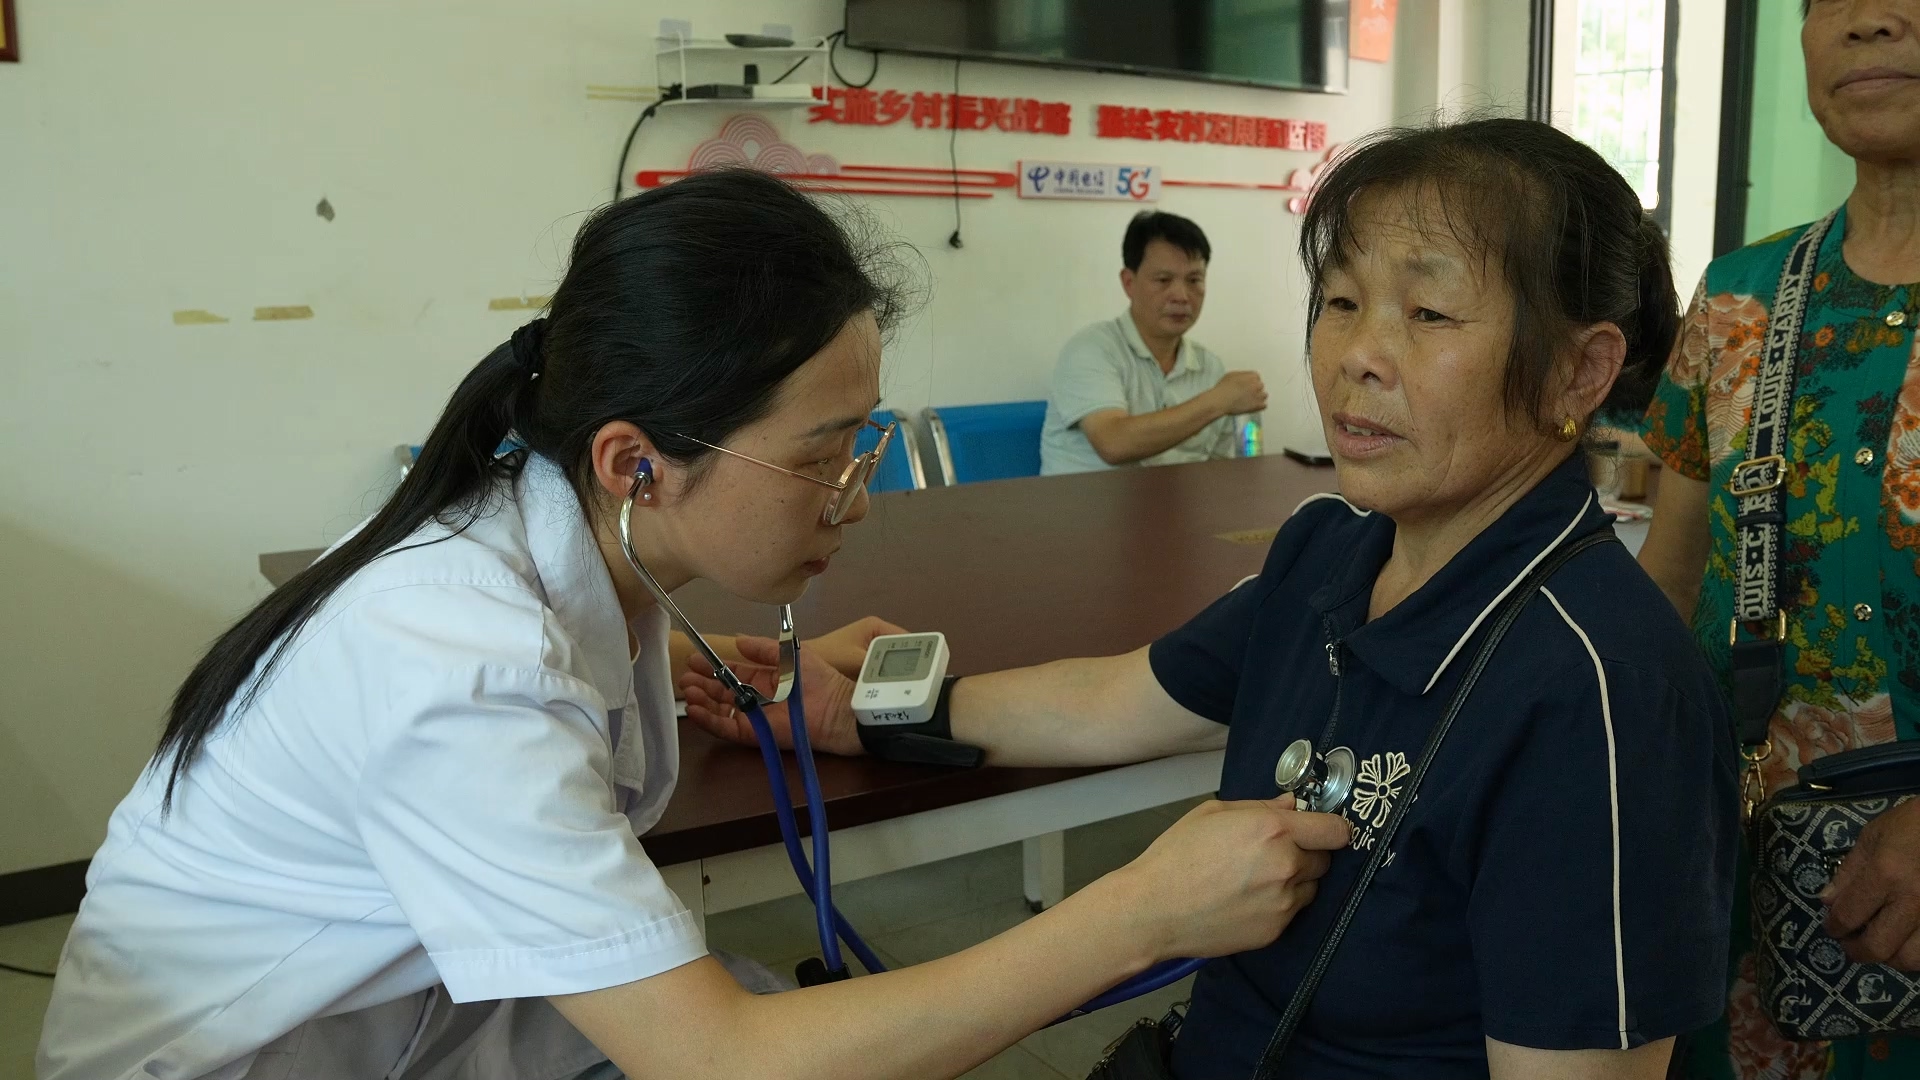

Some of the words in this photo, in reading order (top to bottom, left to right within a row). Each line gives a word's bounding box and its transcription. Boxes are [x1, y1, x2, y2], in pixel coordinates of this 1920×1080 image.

[1054, 168, 1104, 187] 中国电信
[1116, 167, 1151, 200] 5G
